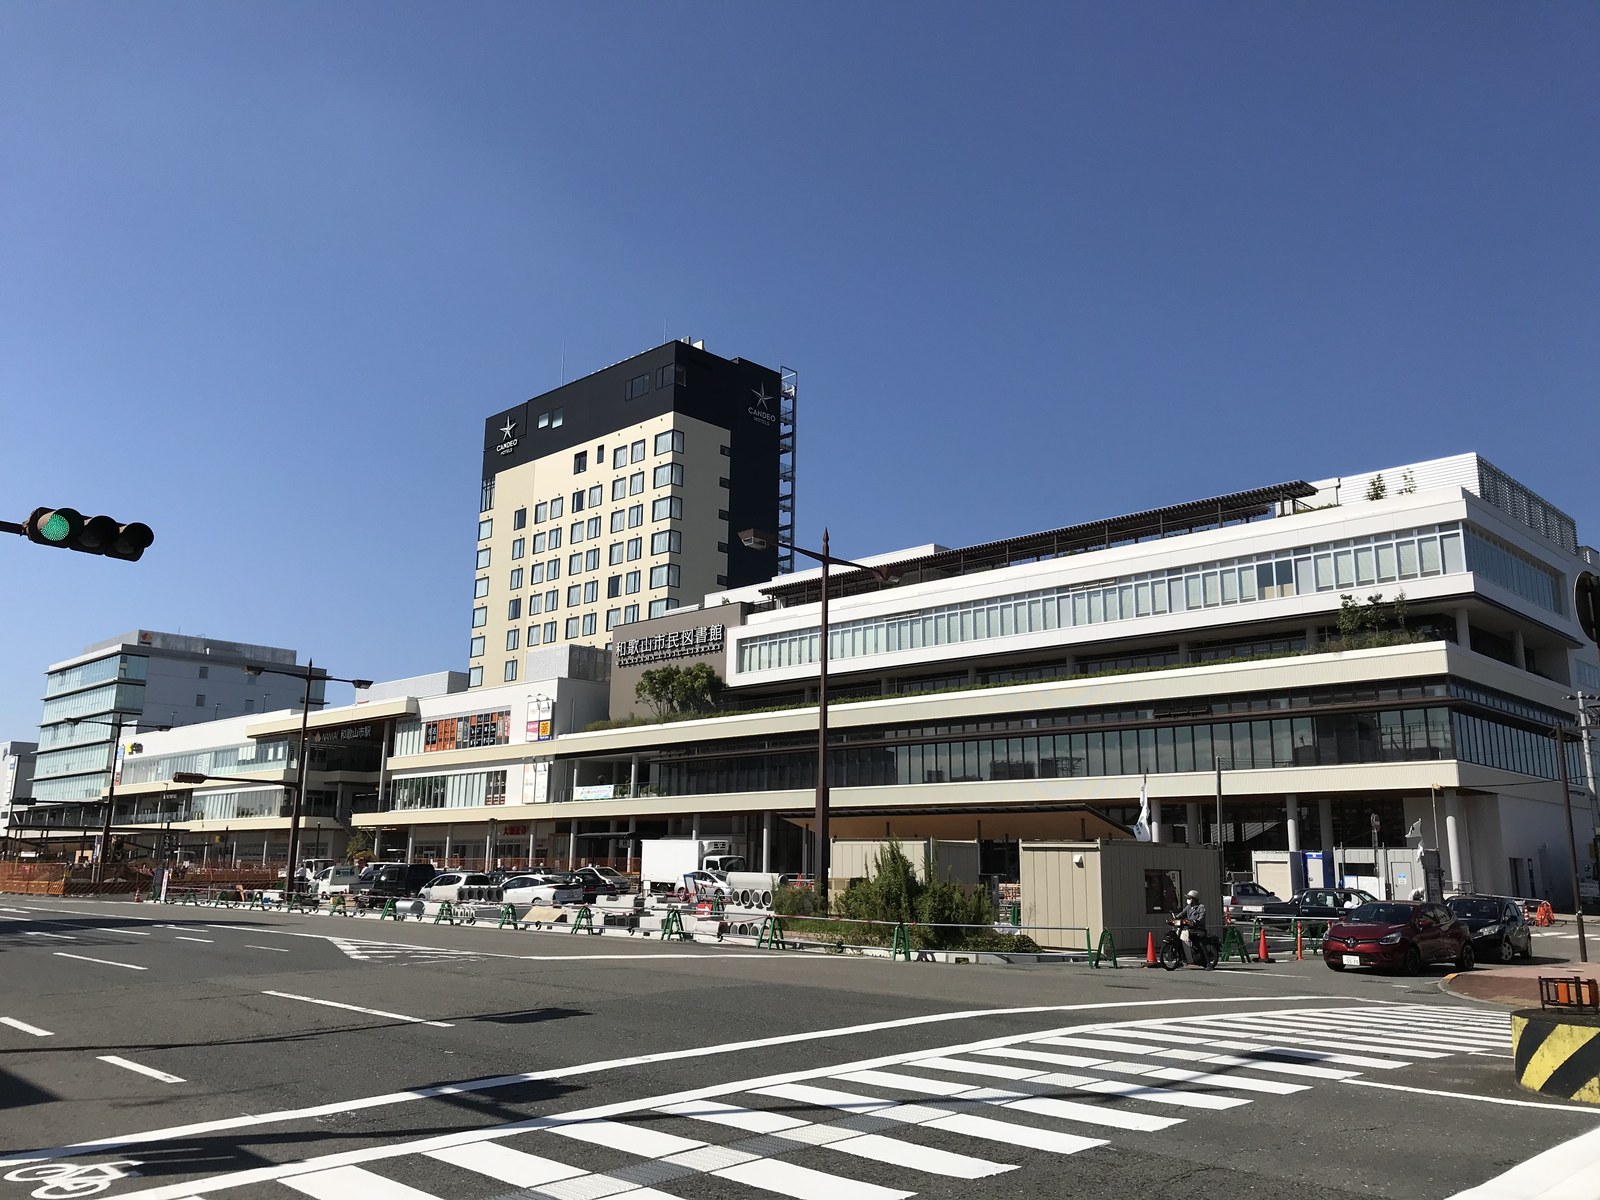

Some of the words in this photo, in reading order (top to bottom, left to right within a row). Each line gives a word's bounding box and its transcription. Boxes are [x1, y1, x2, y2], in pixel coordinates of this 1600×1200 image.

[748, 406, 776, 422] CANDEO
[496, 439, 518, 452] CANDEO
[616, 623, 724, 657] 和歌山市民図書館
[340, 725, 371, 740] 和歌山市駅
